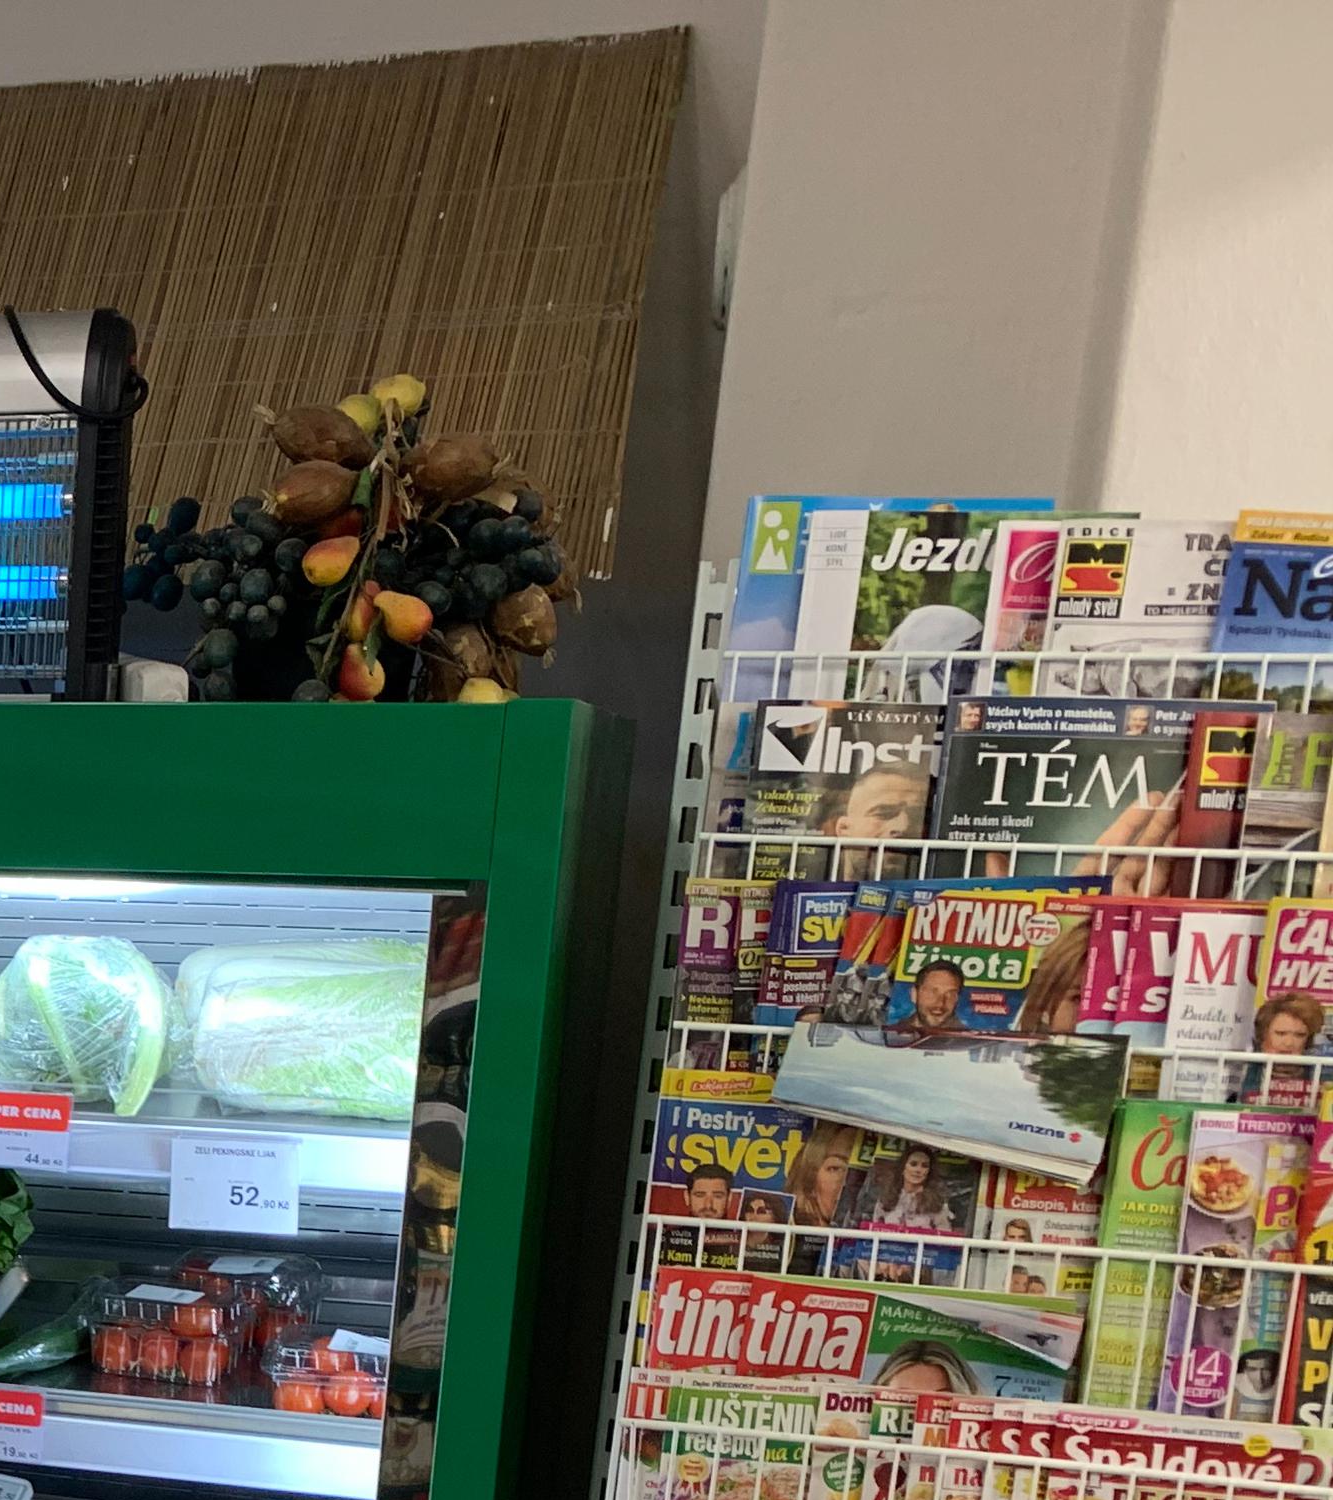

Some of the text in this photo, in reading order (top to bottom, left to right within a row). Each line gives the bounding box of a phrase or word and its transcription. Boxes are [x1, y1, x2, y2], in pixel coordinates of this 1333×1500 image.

[1067, 526, 1136, 537] EDICE
[987, 705, 1020, 718] Václav
[1022, 706, 1052, 722] Vydra
[984, 720, 1015, 733] svých
[949, 814, 1034, 828] Jak nám škodí
[21, 1104, 62, 1122] CENA
[687, 1106, 756, 1133] Pestrý
[1009, 1121, 1066, 1139] SUZUKI
[1239, 1119, 1296, 1134] TRENDY
[748, 1289, 864, 1371] tina
